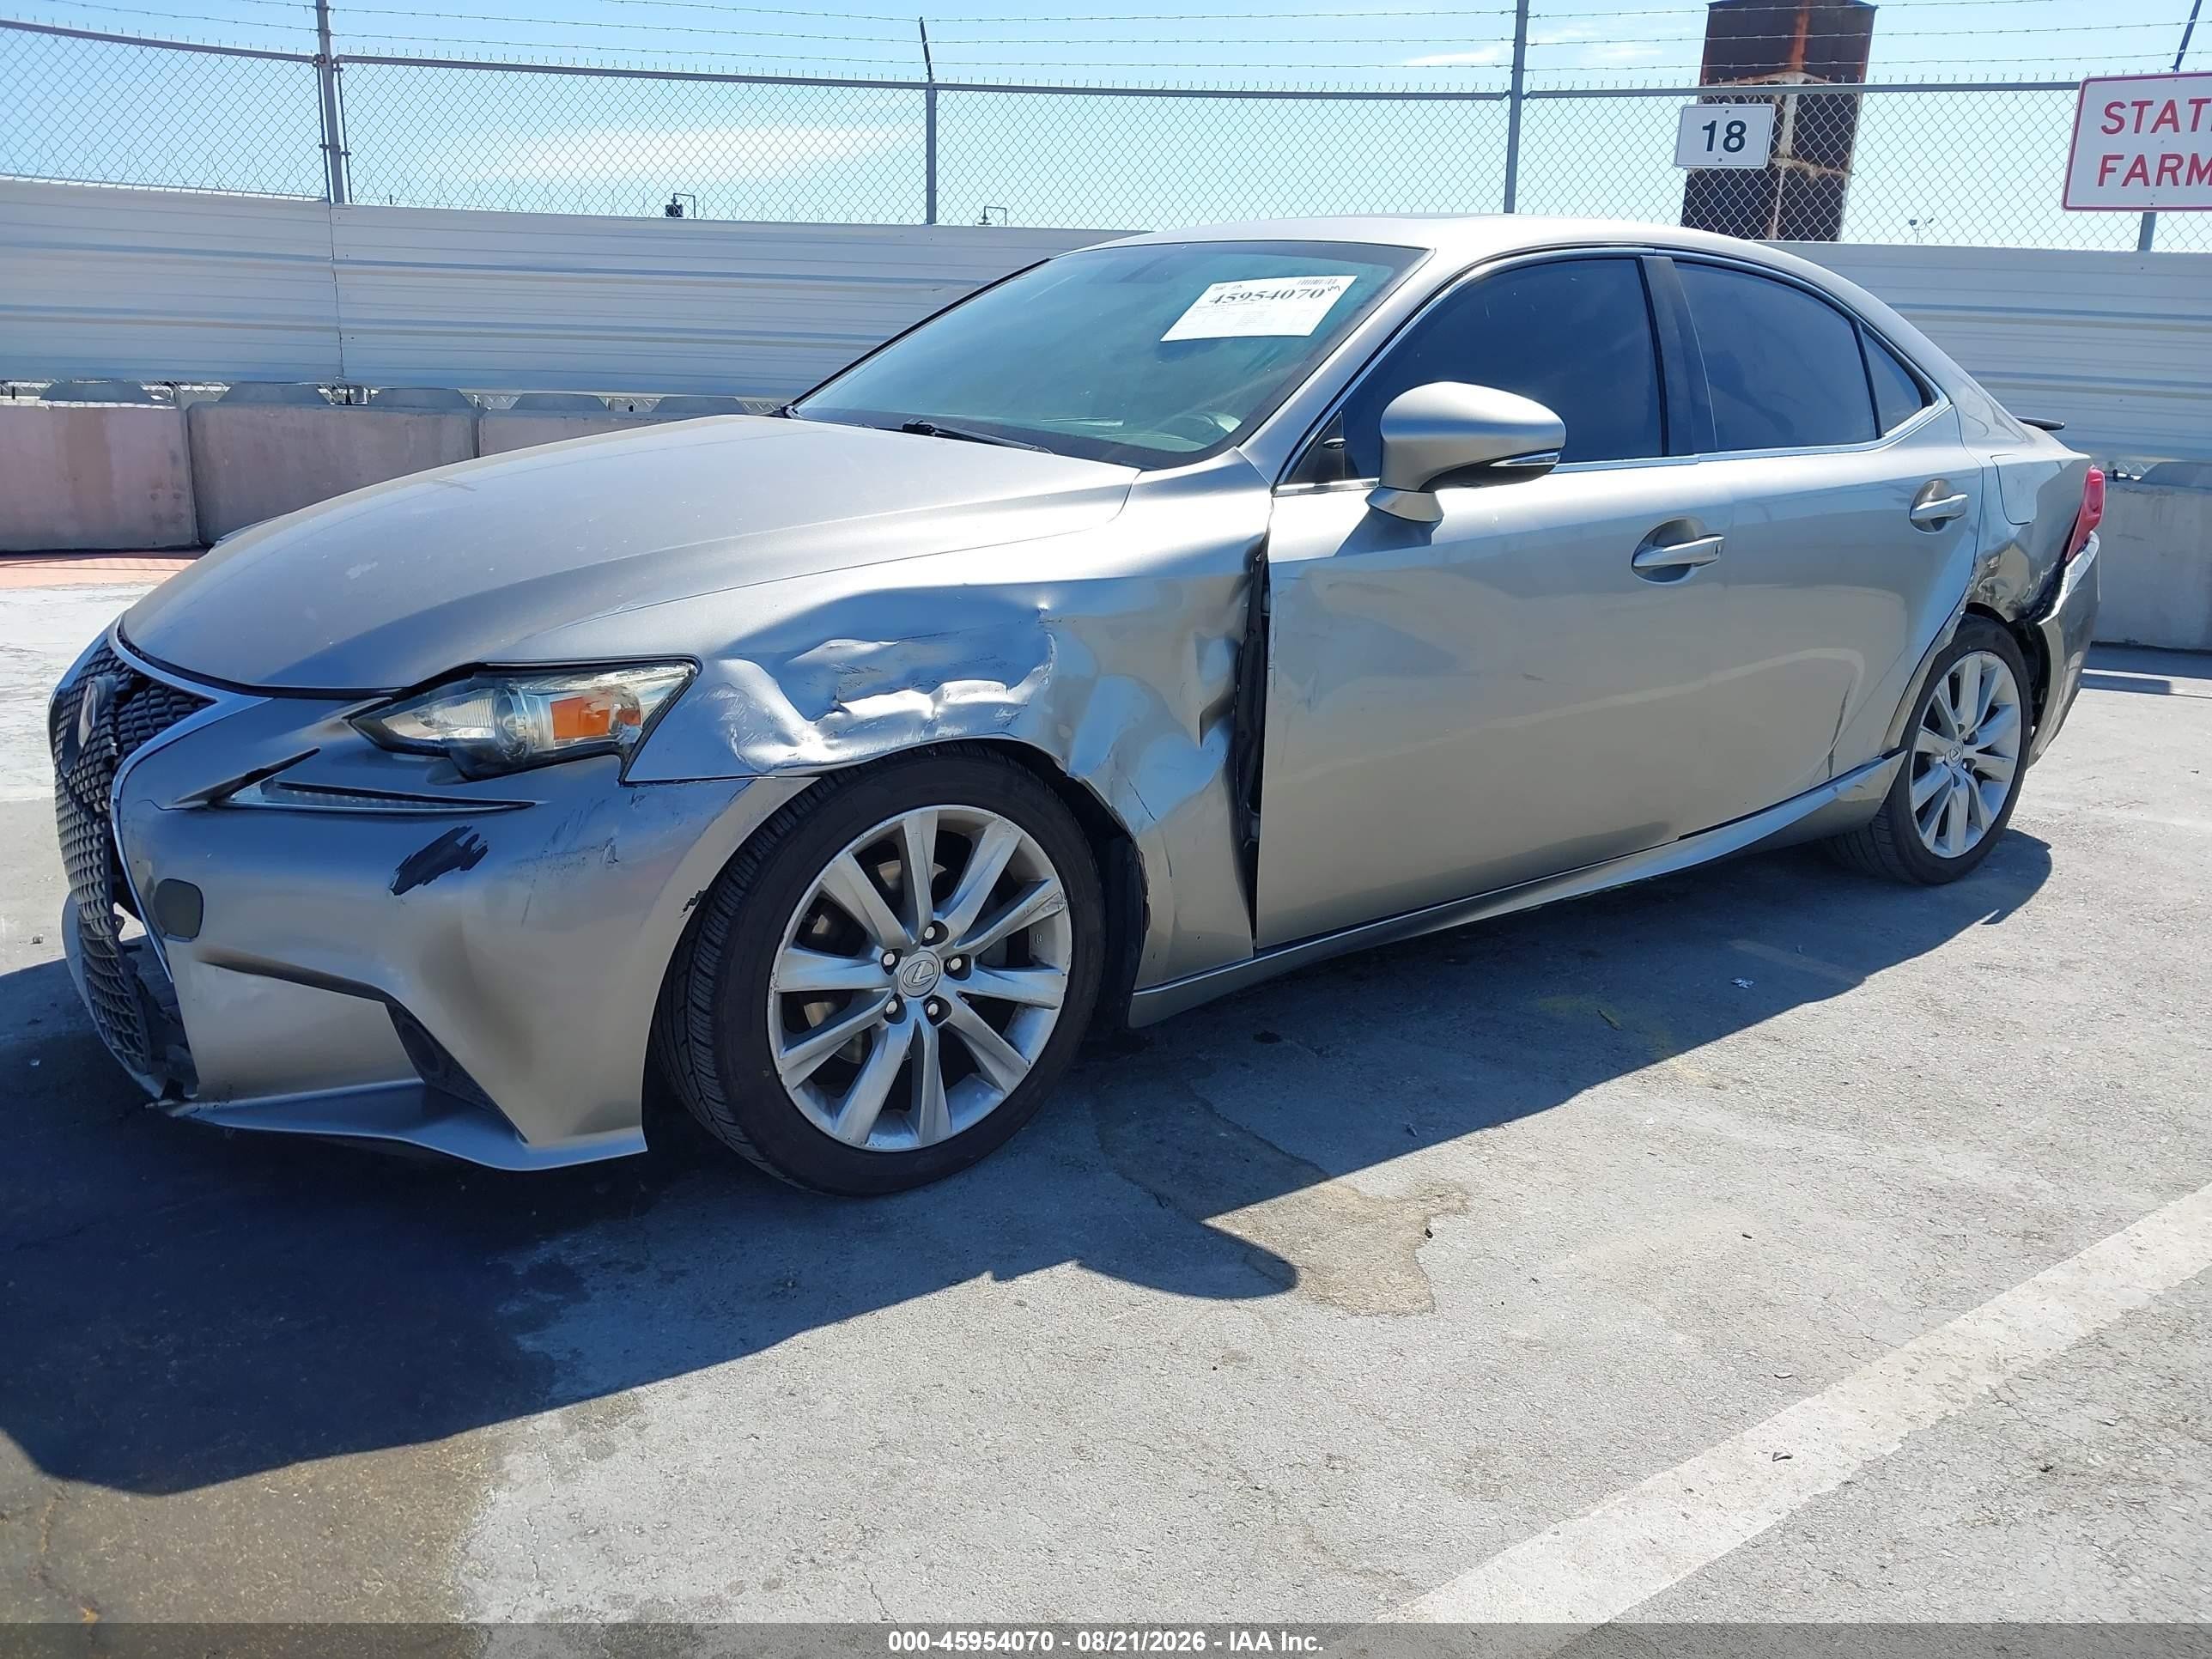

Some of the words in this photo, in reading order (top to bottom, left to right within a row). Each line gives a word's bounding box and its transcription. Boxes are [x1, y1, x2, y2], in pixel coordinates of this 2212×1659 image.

[2100, 98, 2212, 135] STAT
[1702, 119, 1747, 153] 18
[2098, 153, 2212, 187] FARM
[1209, 288, 1326, 305] 45954070
